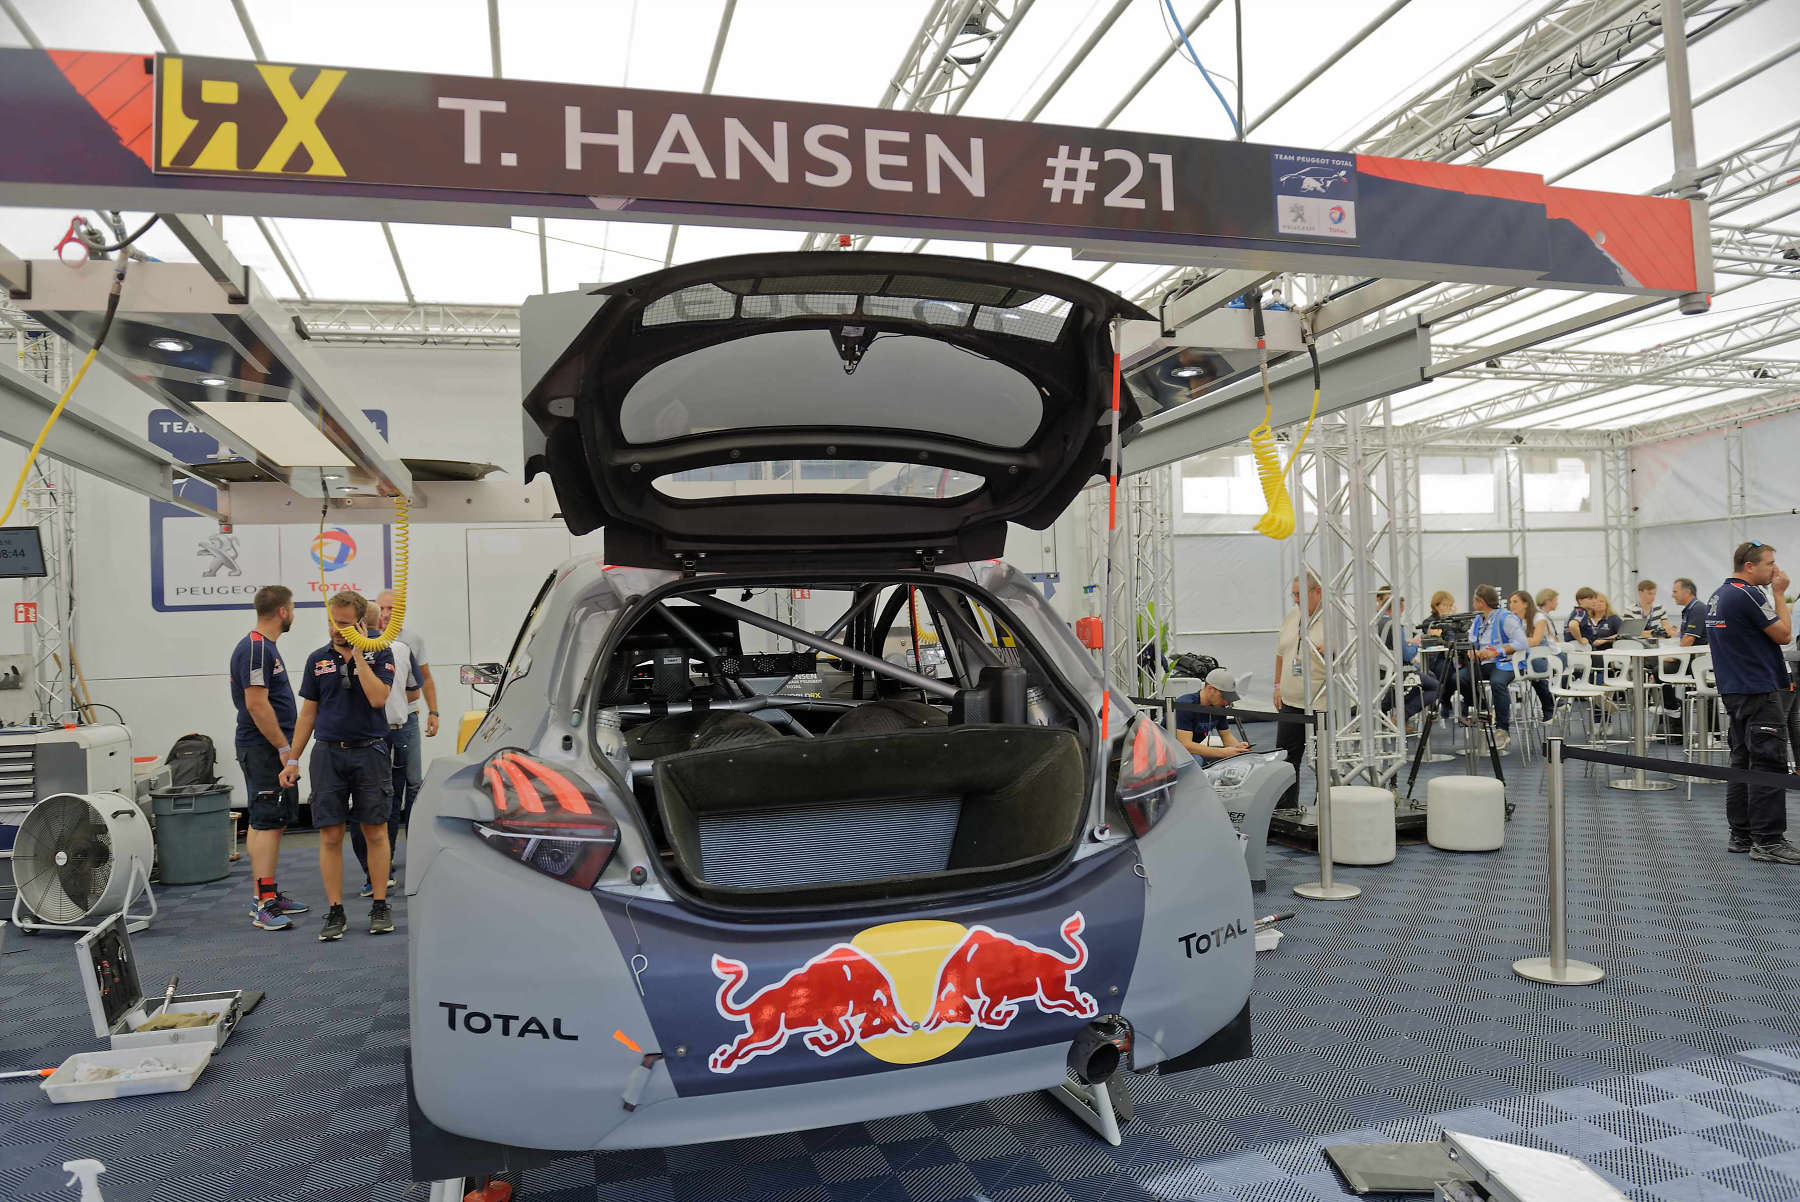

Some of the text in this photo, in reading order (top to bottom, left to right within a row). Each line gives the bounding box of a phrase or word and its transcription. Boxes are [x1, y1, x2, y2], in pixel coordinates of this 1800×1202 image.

[438, 97, 1175, 212] T. HANSEN #21
[1274, 153, 1353, 167] TEAM PEUGEOT TOTAL
[159, 421, 205, 433] TEA
[307, 581, 362, 593] TOTAL
[1178, 918, 1247, 959] TOTAL
[438, 1001, 579, 1041] TOTAL
